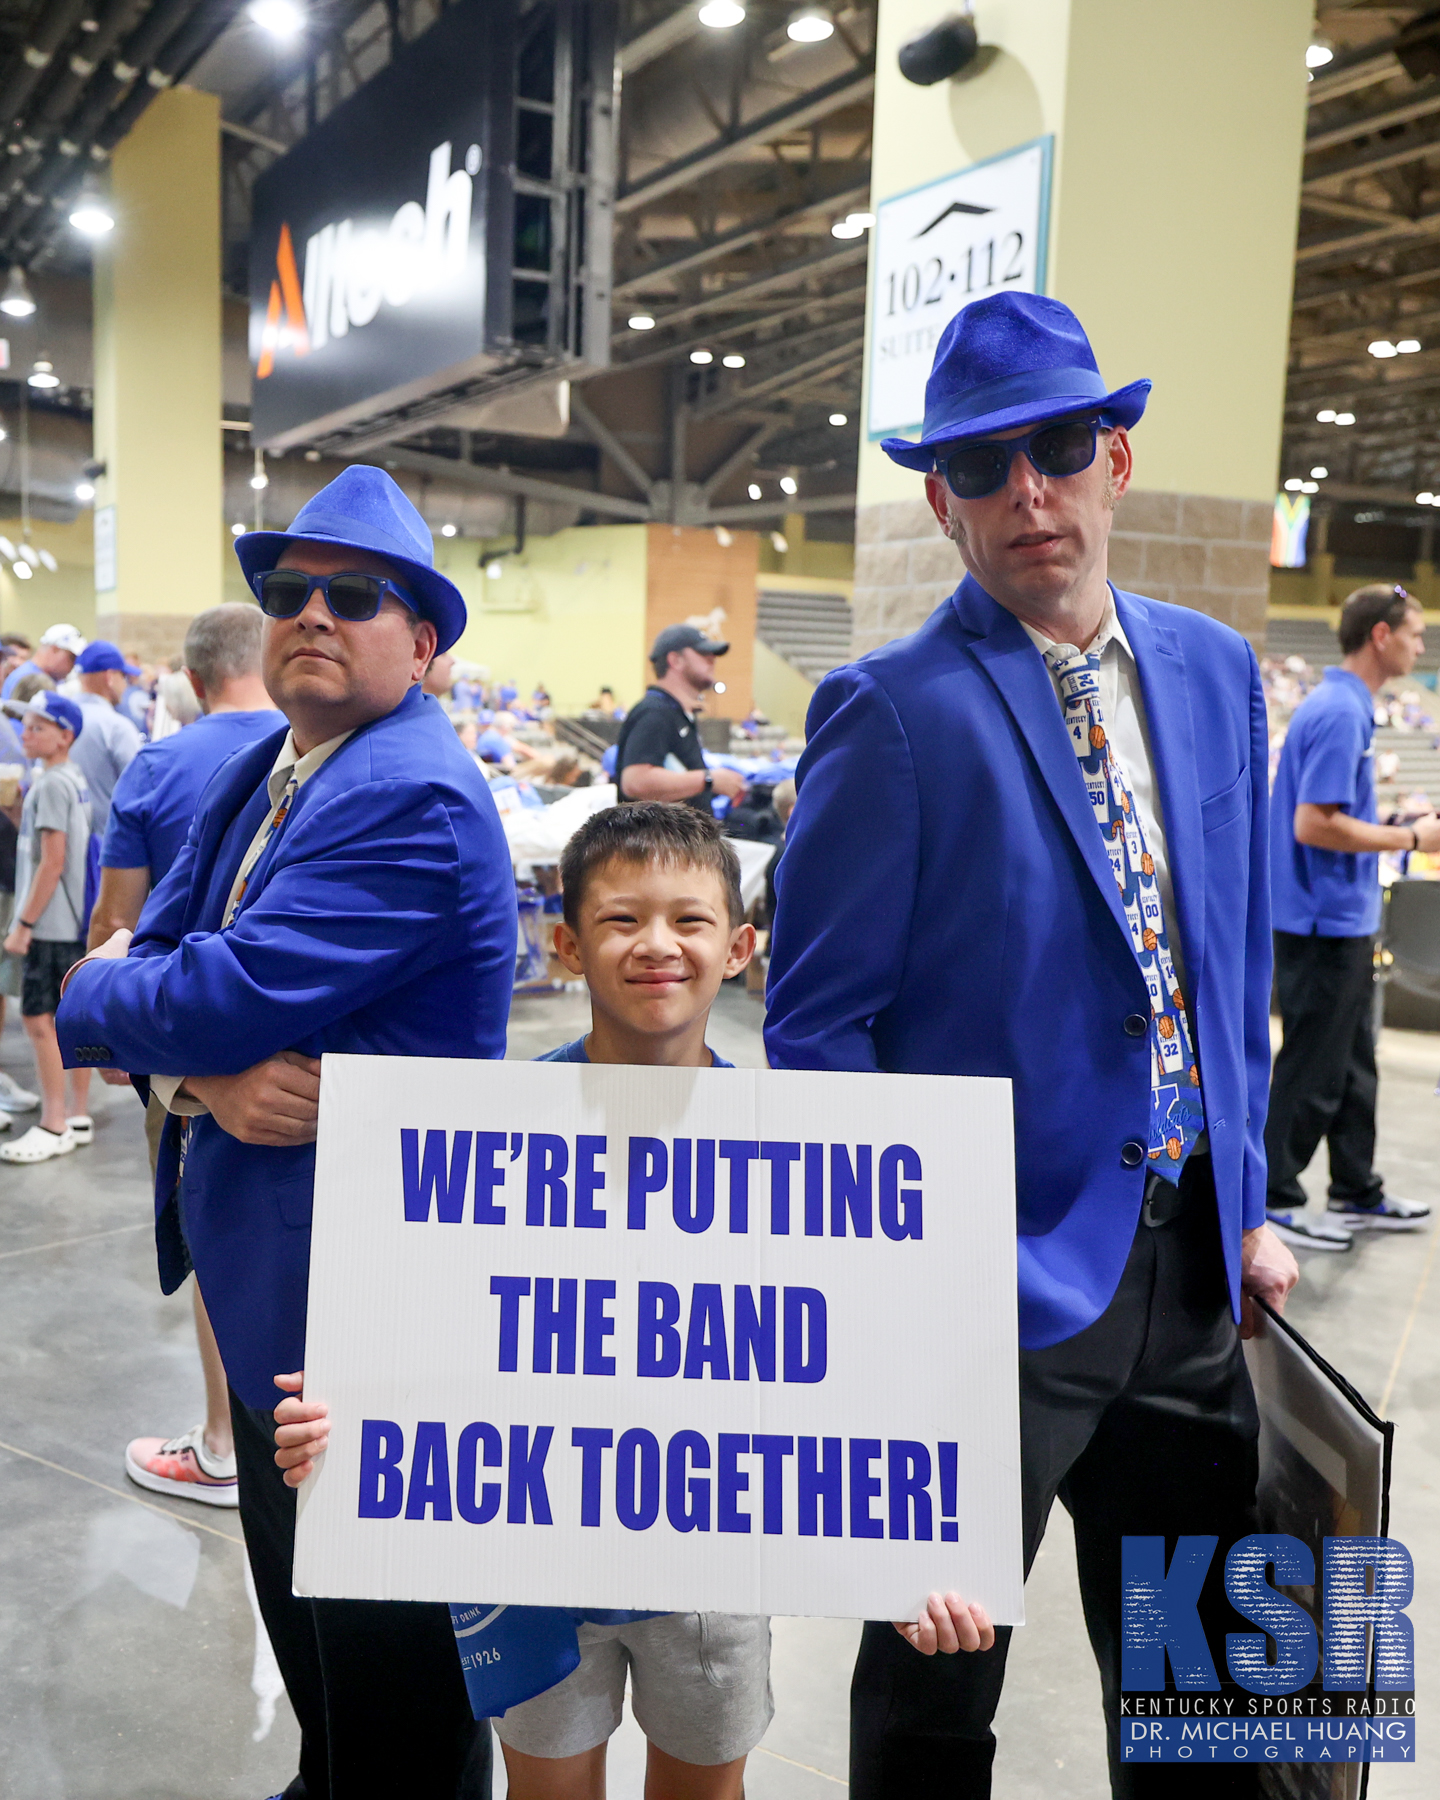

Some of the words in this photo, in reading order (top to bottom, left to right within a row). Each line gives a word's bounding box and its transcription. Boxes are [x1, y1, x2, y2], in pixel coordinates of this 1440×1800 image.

[1073, 725, 1082, 740] 4
[1089, 791, 1105, 806] 50
[1131, 841, 1138, 855] 3
[1145, 903, 1159, 918] 00
[1146, 983, 1158, 997] 0
[1163, 1042, 1179, 1058] 32
[628, 1136, 923, 1241] PUTTING
[491, 1276, 616, 1376] THE
[638, 1282, 827, 1384] BAND
[359, 1420, 555, 1525] BACK
[573, 1428, 959, 1542] TOGETHER!
[459, 1606, 481, 1623] DRINK
[470, 1647, 501, 1669] 1926
